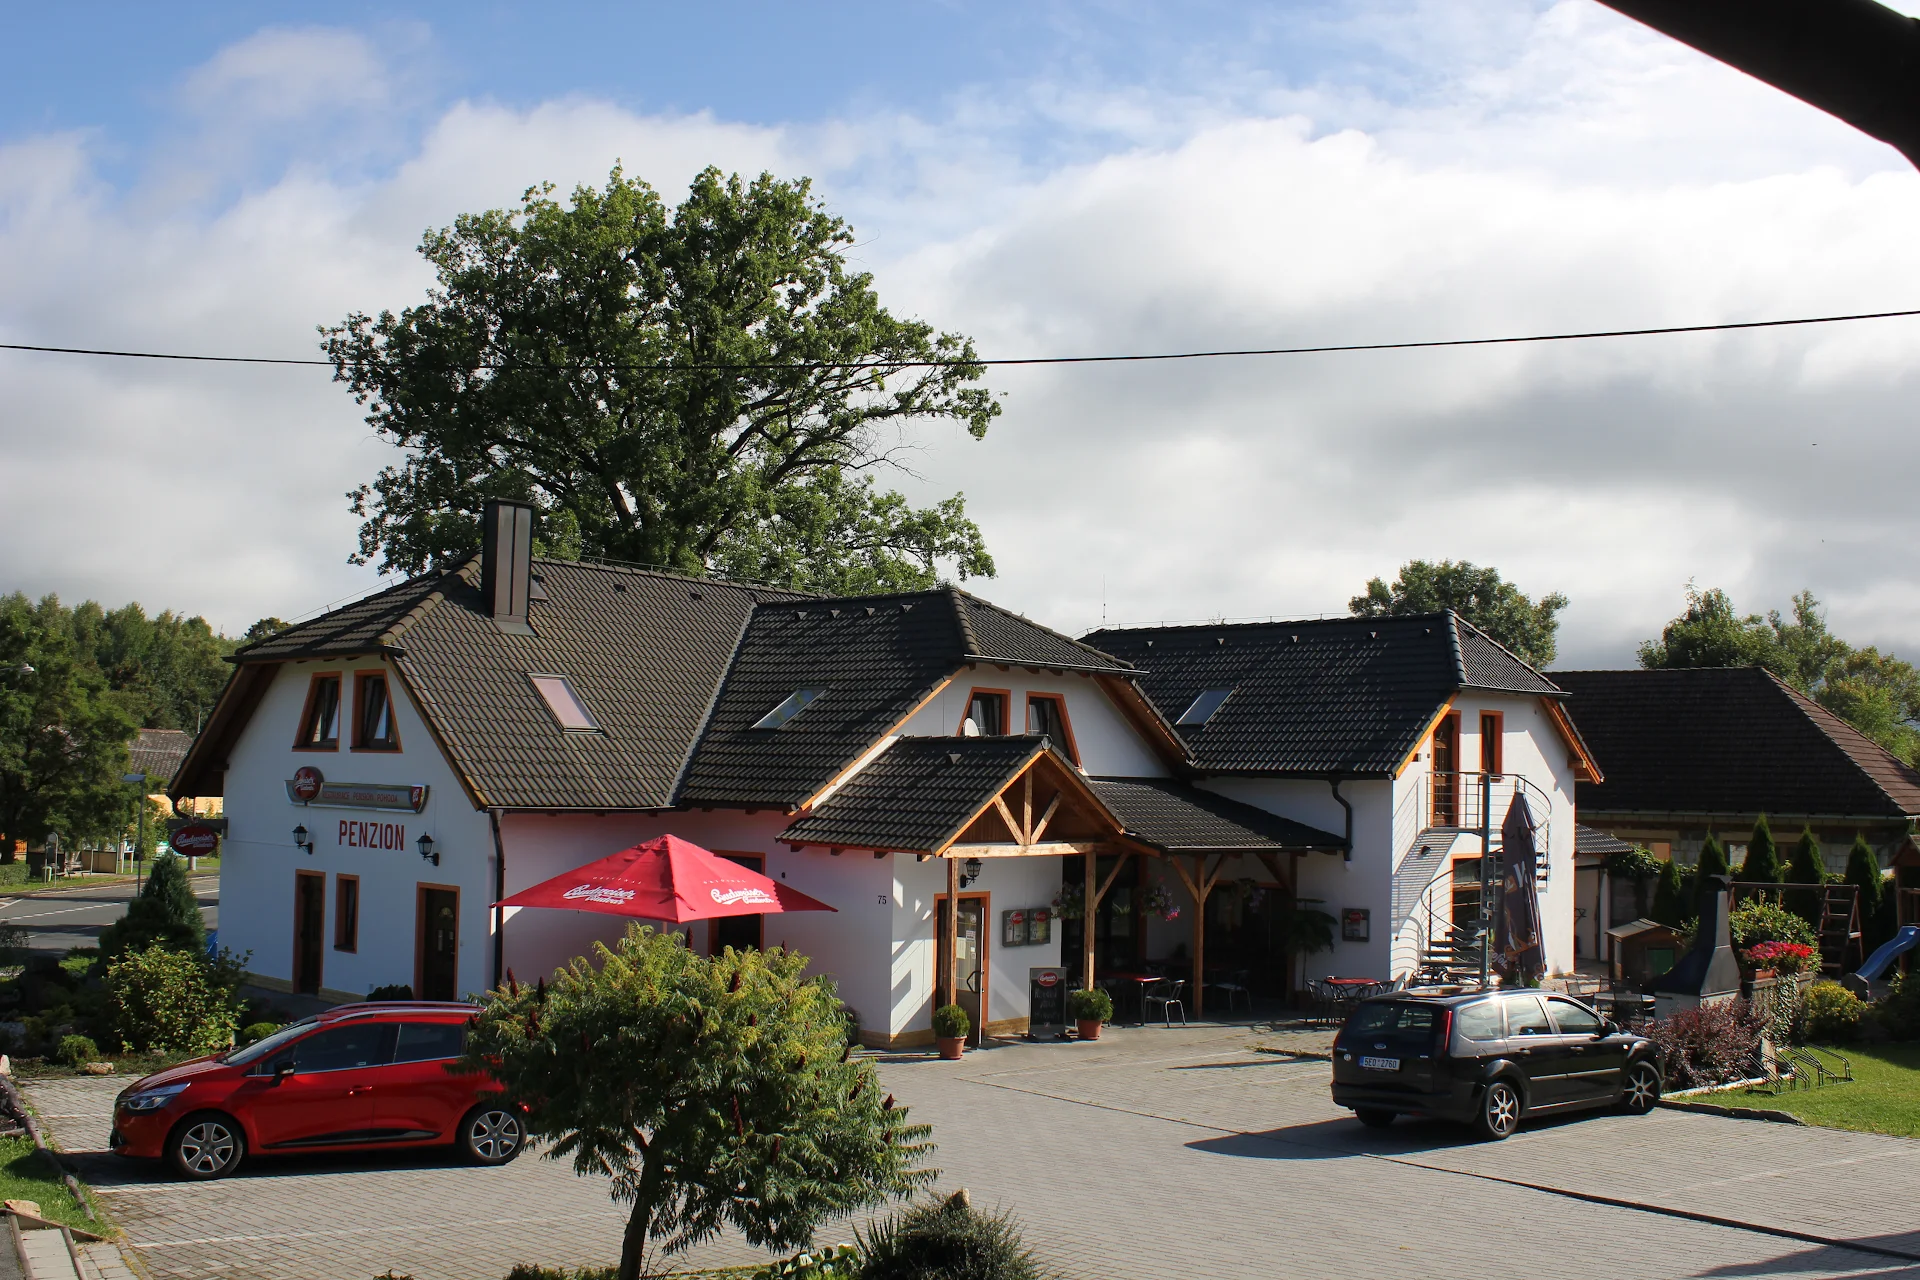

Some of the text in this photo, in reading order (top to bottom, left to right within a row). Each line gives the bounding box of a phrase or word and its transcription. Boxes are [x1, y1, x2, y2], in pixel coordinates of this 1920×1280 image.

[338, 820, 404, 851] PENZION
[563, 884, 636, 900] Budweiser
[710, 888, 770, 904] Budweiser
[878, 896, 886, 904] 75
[1380, 1060, 1396, 1068] 2760
